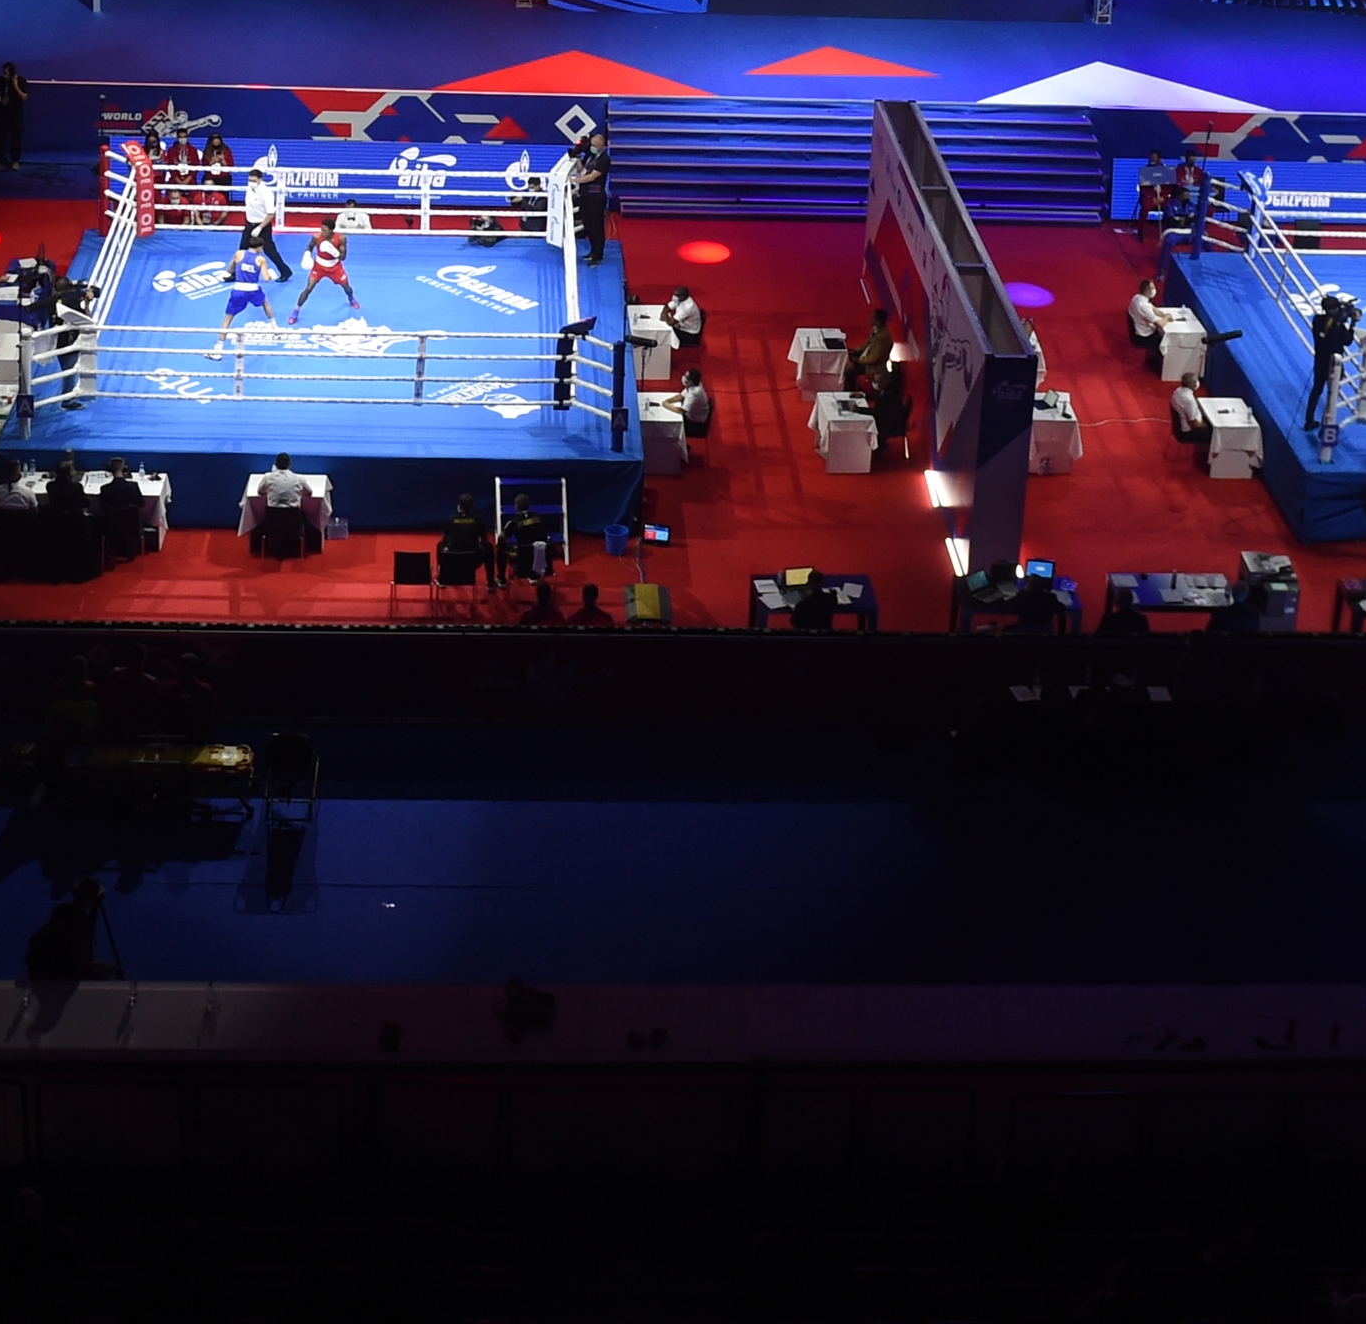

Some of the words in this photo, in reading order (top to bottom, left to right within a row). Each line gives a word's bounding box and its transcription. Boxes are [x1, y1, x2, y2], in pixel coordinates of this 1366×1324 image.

[102, 112, 142, 122] WORLD
[241, 263, 256, 274] BEL
[415, 275, 464, 296] GENERAL
[464, 294, 517, 316] PARTNER
[1324, 428, 1337, 443] B
